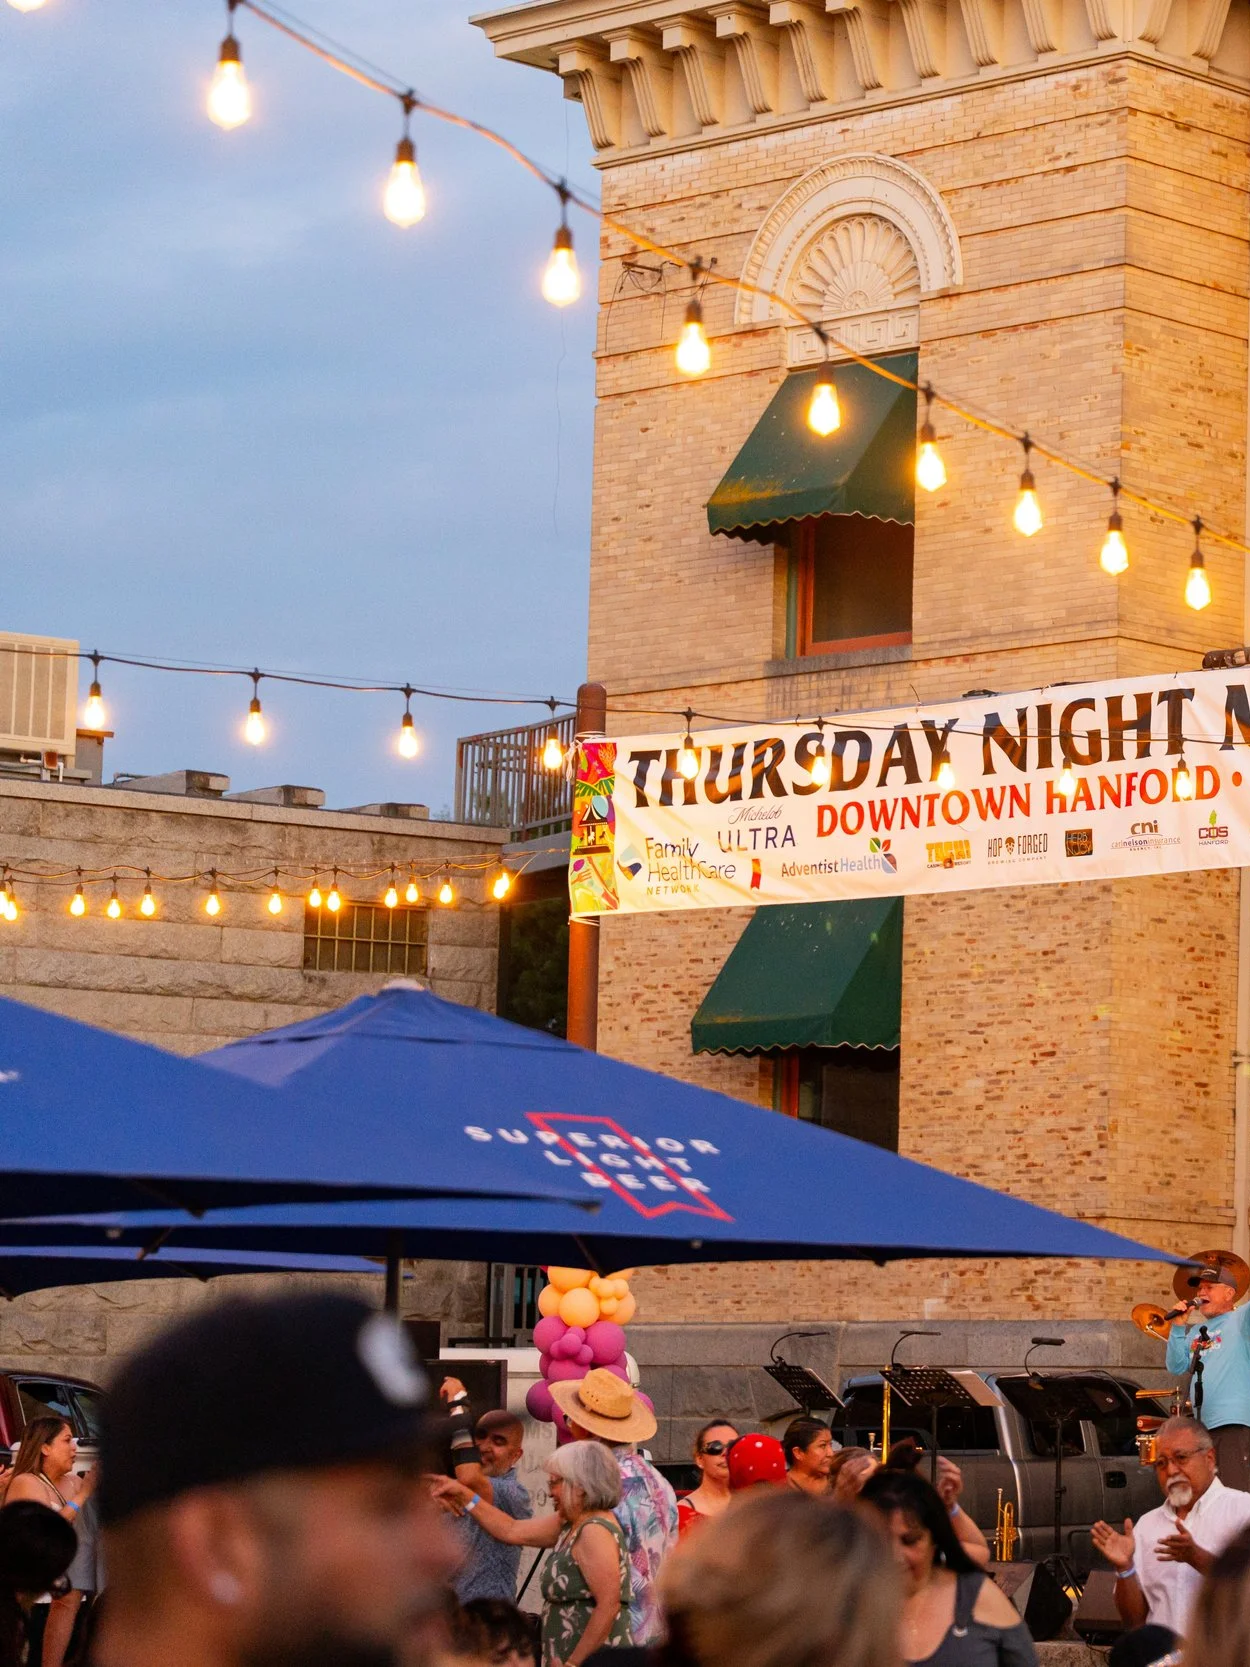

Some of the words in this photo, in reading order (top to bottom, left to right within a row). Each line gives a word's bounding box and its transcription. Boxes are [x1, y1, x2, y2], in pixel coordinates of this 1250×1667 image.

[628, 718, 959, 808] THURSDAY
[982, 688, 1195, 775] NIGHT
[728, 805, 783, 825] Michelob
[817, 783, 1031, 838] DOWNTOWN
[718, 825, 796, 853] ULTRA
[1130, 820, 1159, 835] cni
[1198, 826, 1229, 840] COS
[645, 837, 699, 860] Family
[988, 838, 1003, 858] HOP
[1017, 833, 1049, 855] FORGED
[464, 1125, 721, 1155] SUPERIOR
[544, 1150, 693, 1173] LIGHT
[580, 1171, 711, 1193] BEER
